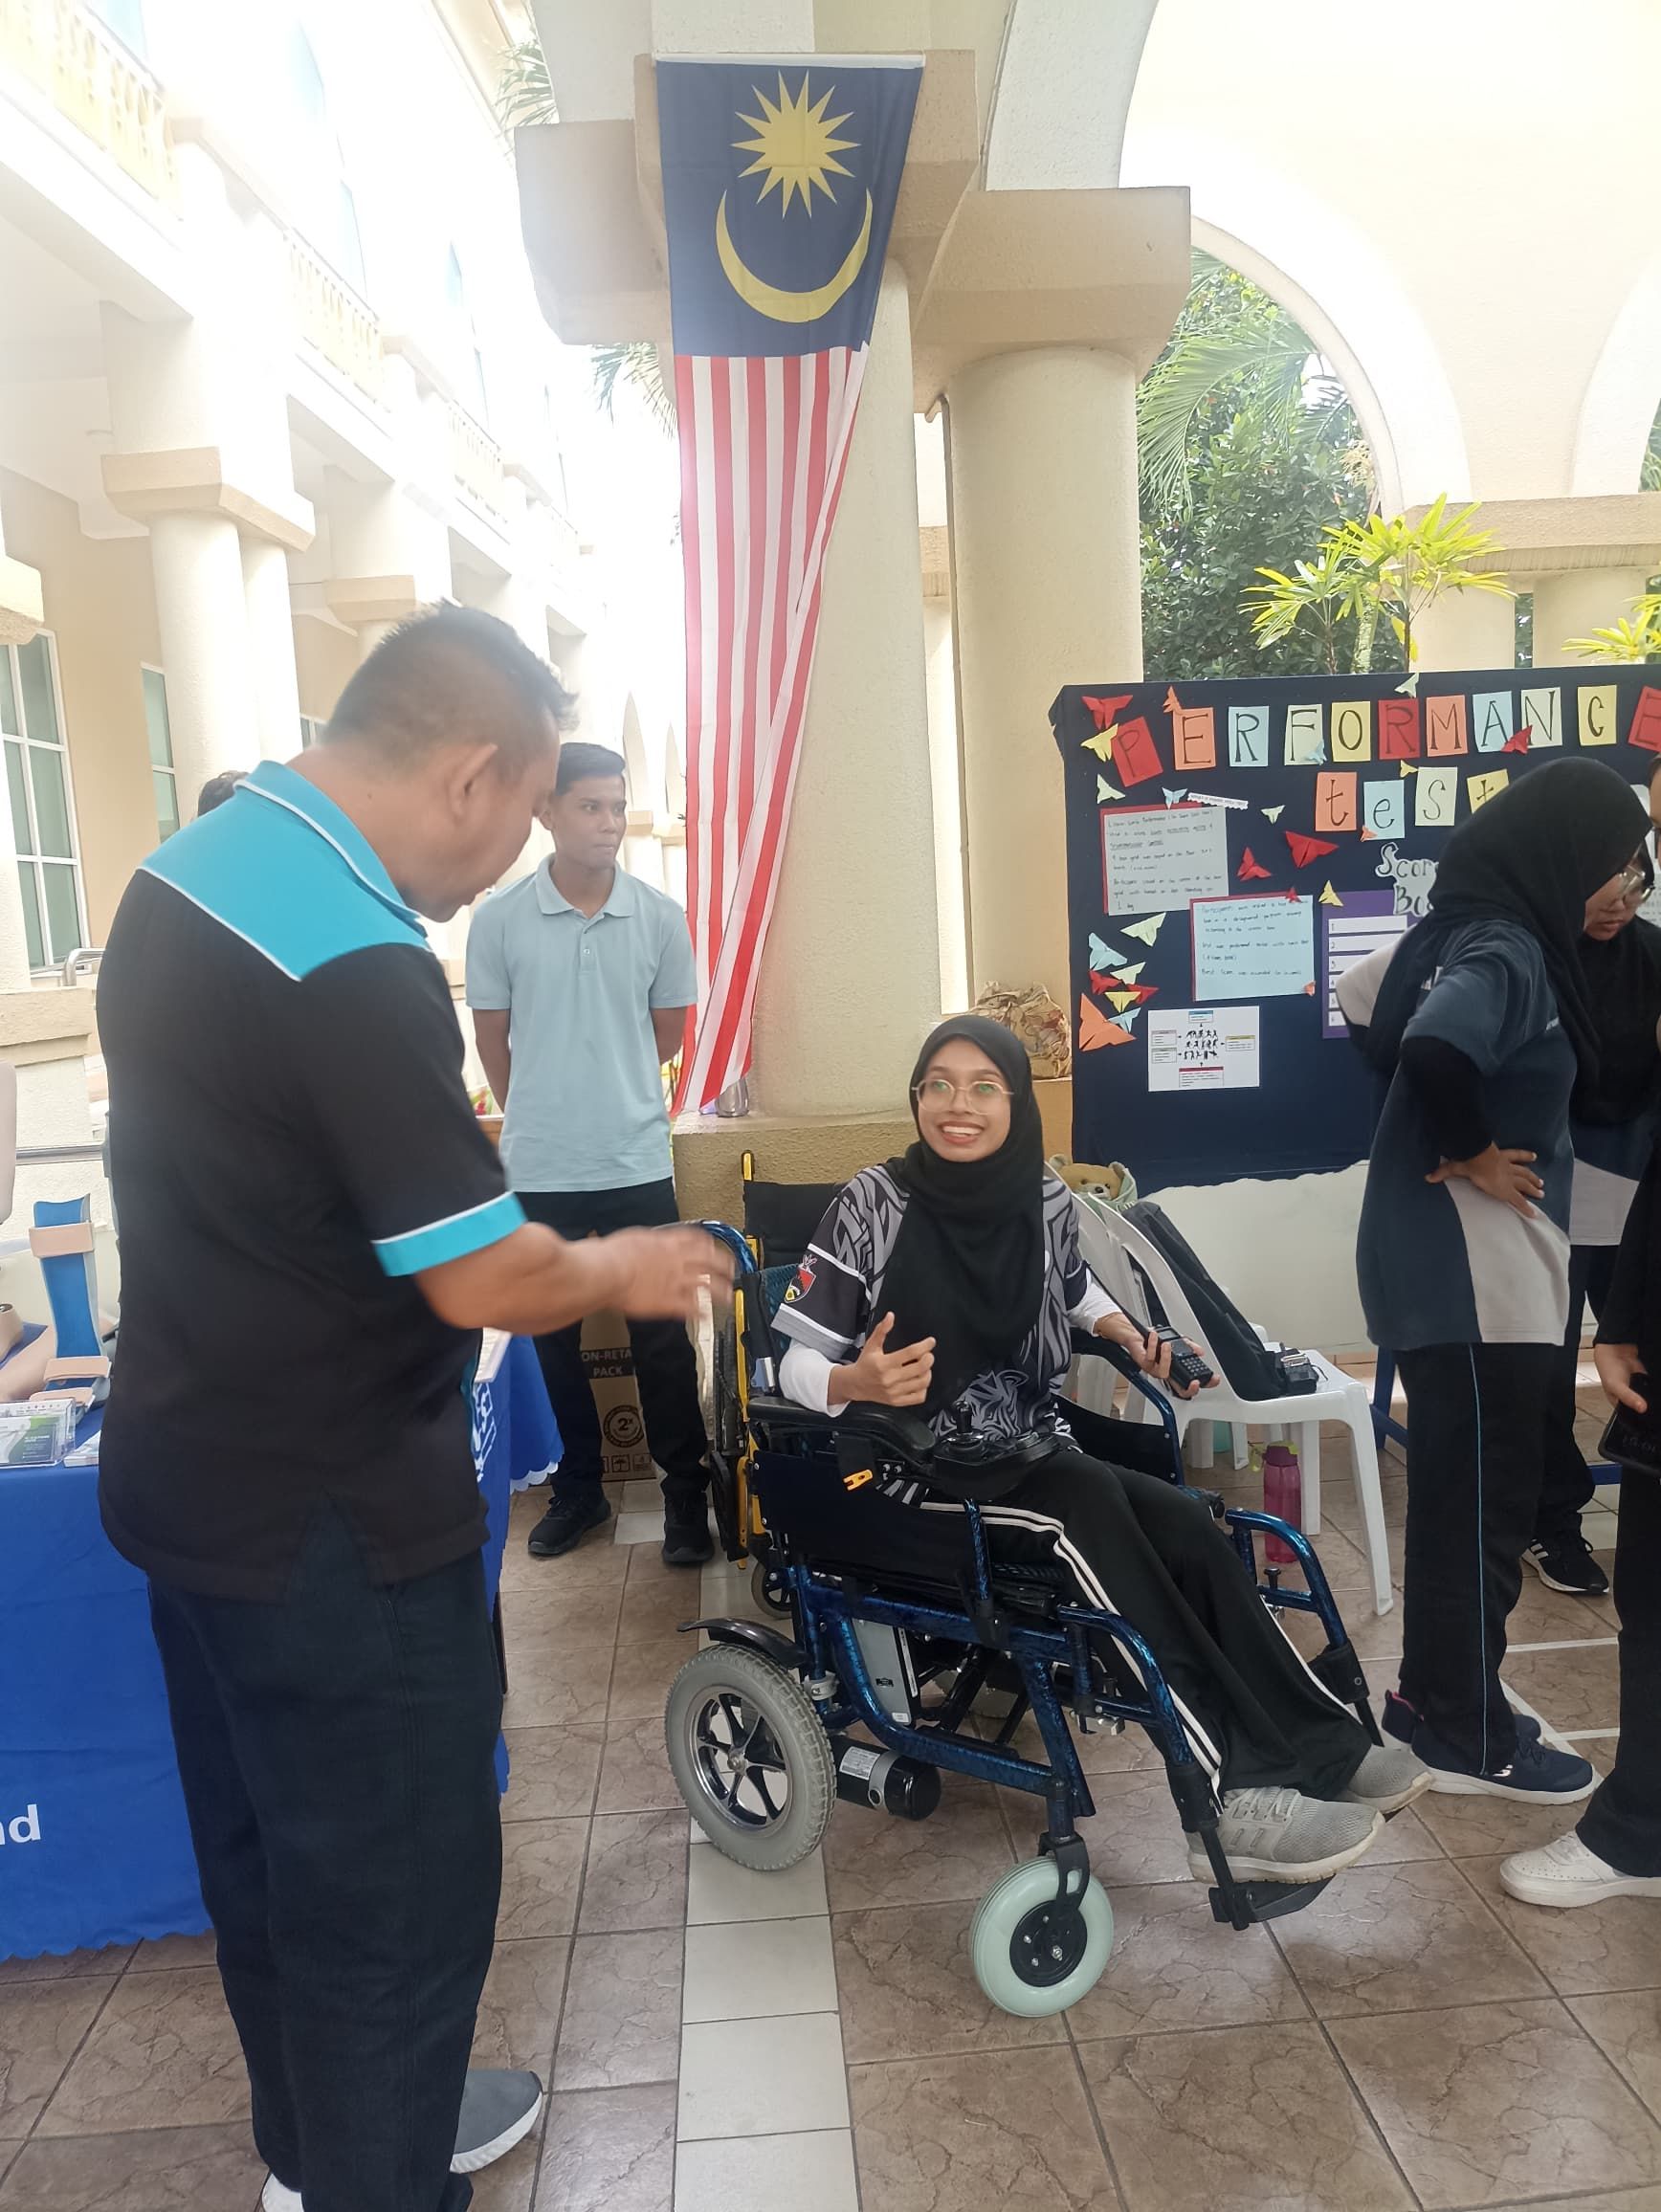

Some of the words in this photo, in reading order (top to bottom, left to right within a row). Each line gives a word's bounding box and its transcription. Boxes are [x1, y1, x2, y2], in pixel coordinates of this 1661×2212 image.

[1117, 690, 1661, 778] PERFORMANCE
[1378, 843, 1433, 878] Scor
[581, 1349, 632, 1362] ON-RETA
[593, 1365, 623, 1378] PACK
[0, 1803, 41, 1846] d
